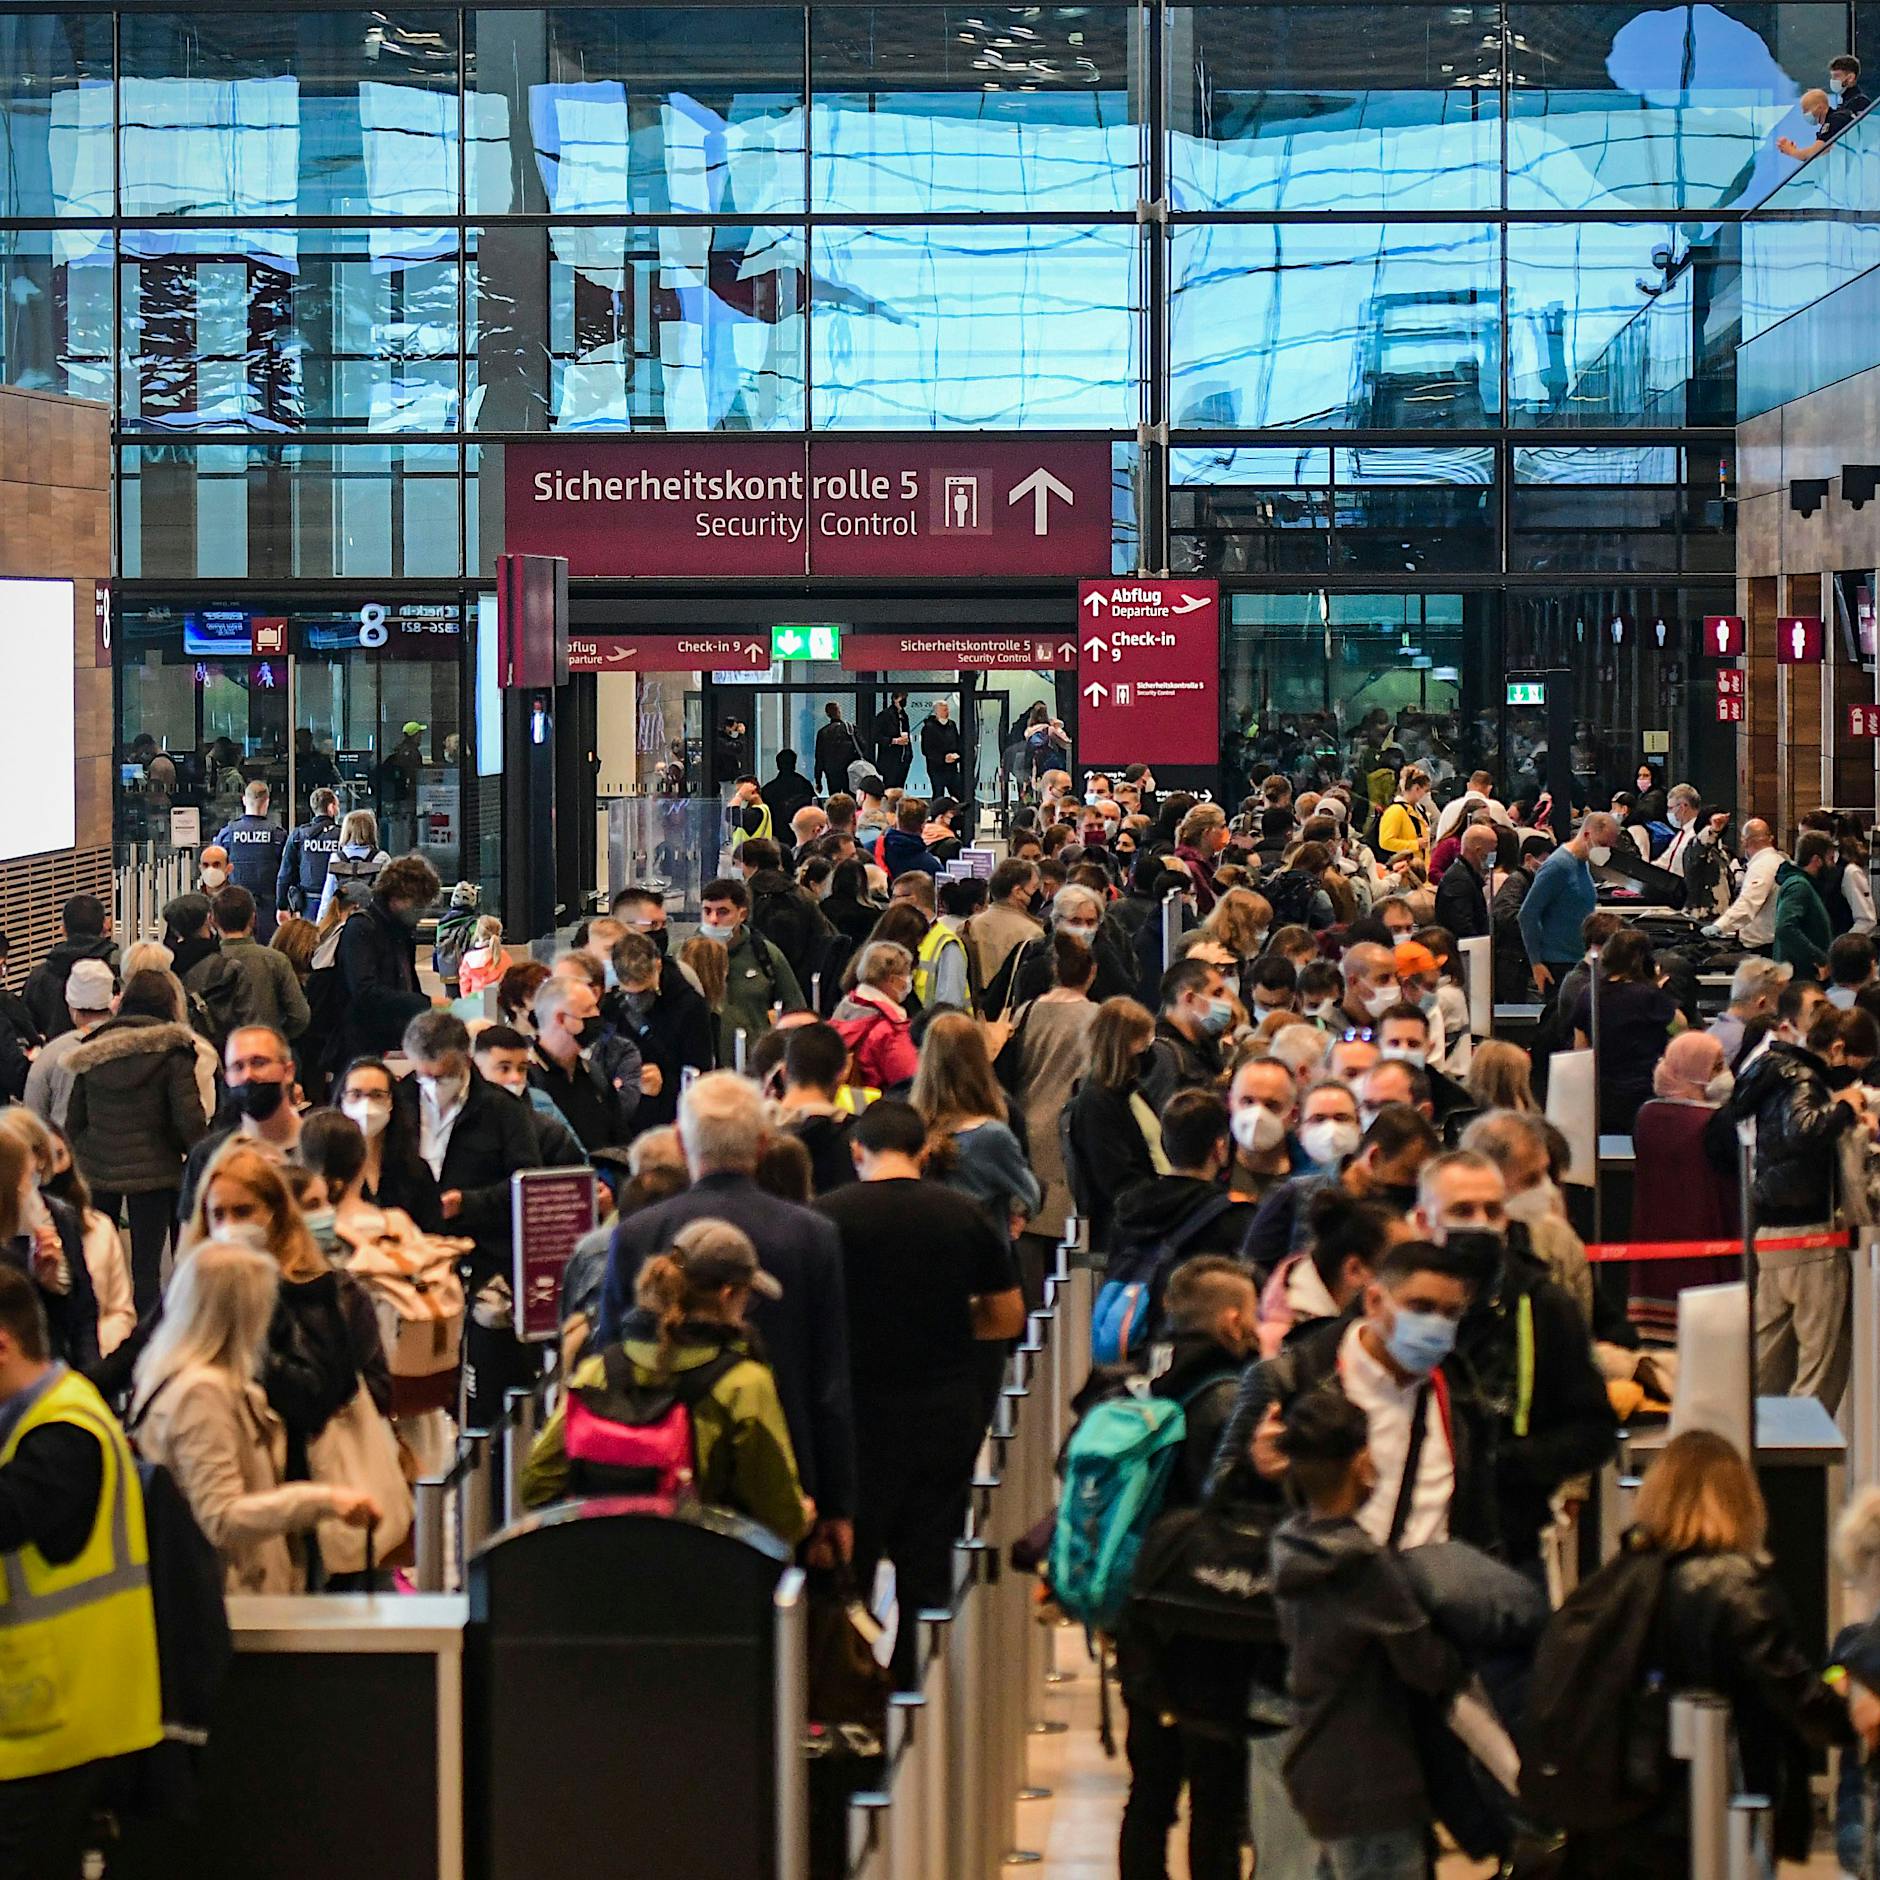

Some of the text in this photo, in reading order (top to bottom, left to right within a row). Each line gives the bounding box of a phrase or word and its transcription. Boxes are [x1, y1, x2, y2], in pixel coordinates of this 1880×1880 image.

[533, 468, 919, 500] Sicherheitskontrolle 5
[695, 510, 918, 543] Security Control
[1111, 588, 1162, 606] Abflug
[1111, 605, 1170, 619] Departure
[900, 639, 1031, 652] Sicherheitskontrolle 5
[1111, 631, 1176, 646] Check-in
[677, 640, 741, 653] Check-in 9
[568, 655, 603, 667] parture
[957, 653, 1031, 666] Security Control
[1111, 648, 1122, 662] 9
[233, 831, 271, 844] POLIZEI
